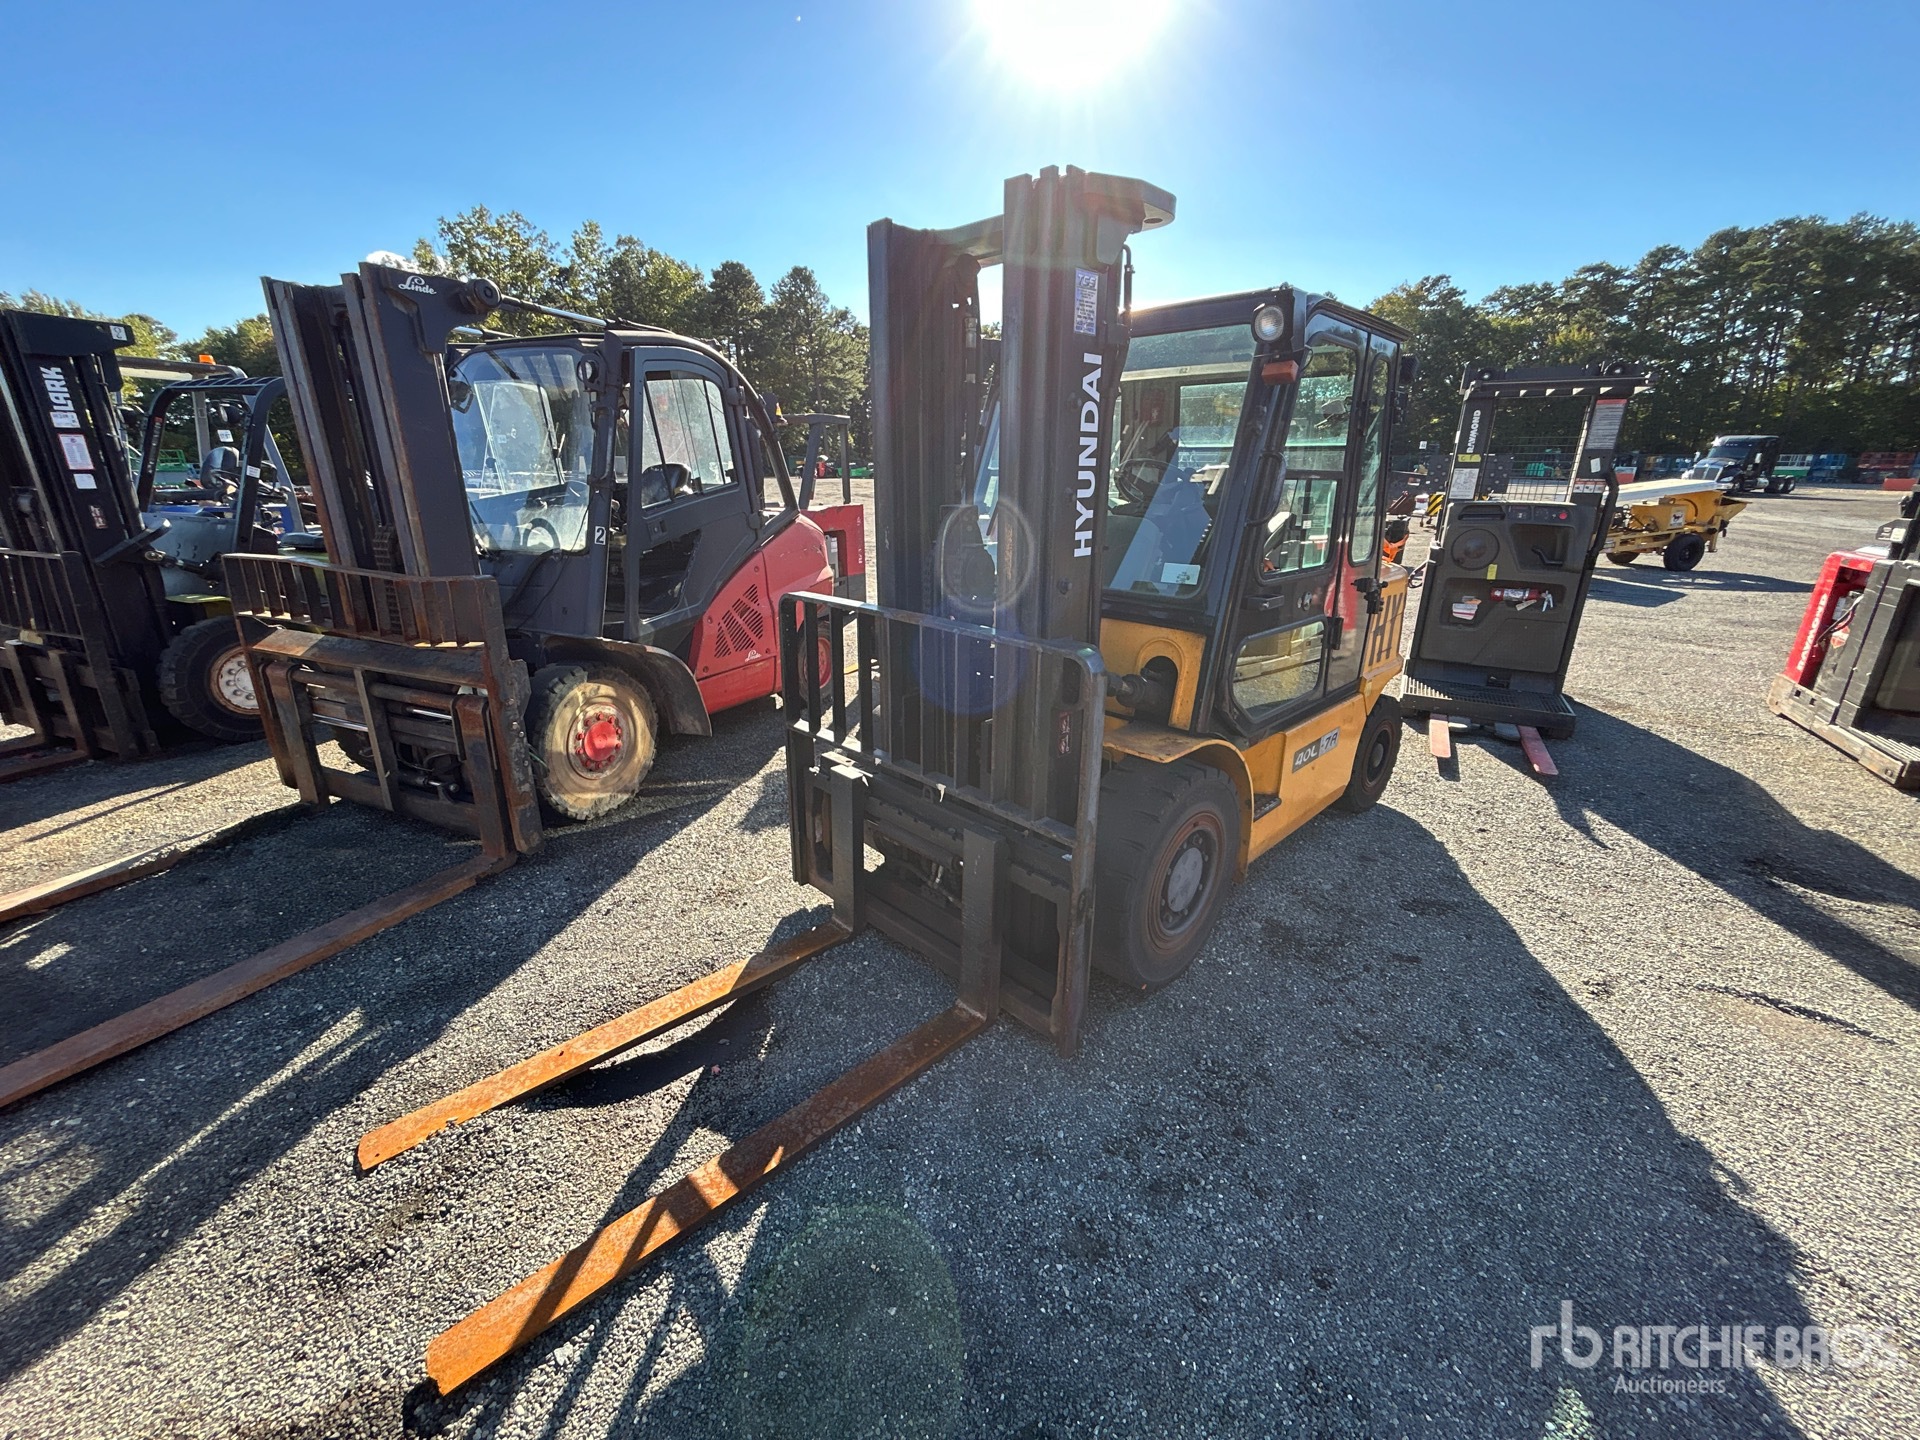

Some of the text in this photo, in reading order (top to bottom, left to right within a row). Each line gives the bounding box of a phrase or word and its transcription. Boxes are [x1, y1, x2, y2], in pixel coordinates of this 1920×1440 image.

[398, 275, 437, 294] Linde
[39, 366, 75, 411] LARK
[1466, 409, 1482, 453] RAYMOND
[1074, 353, 1102, 557] HYUNDAI
[596, 527, 605, 544] 2
